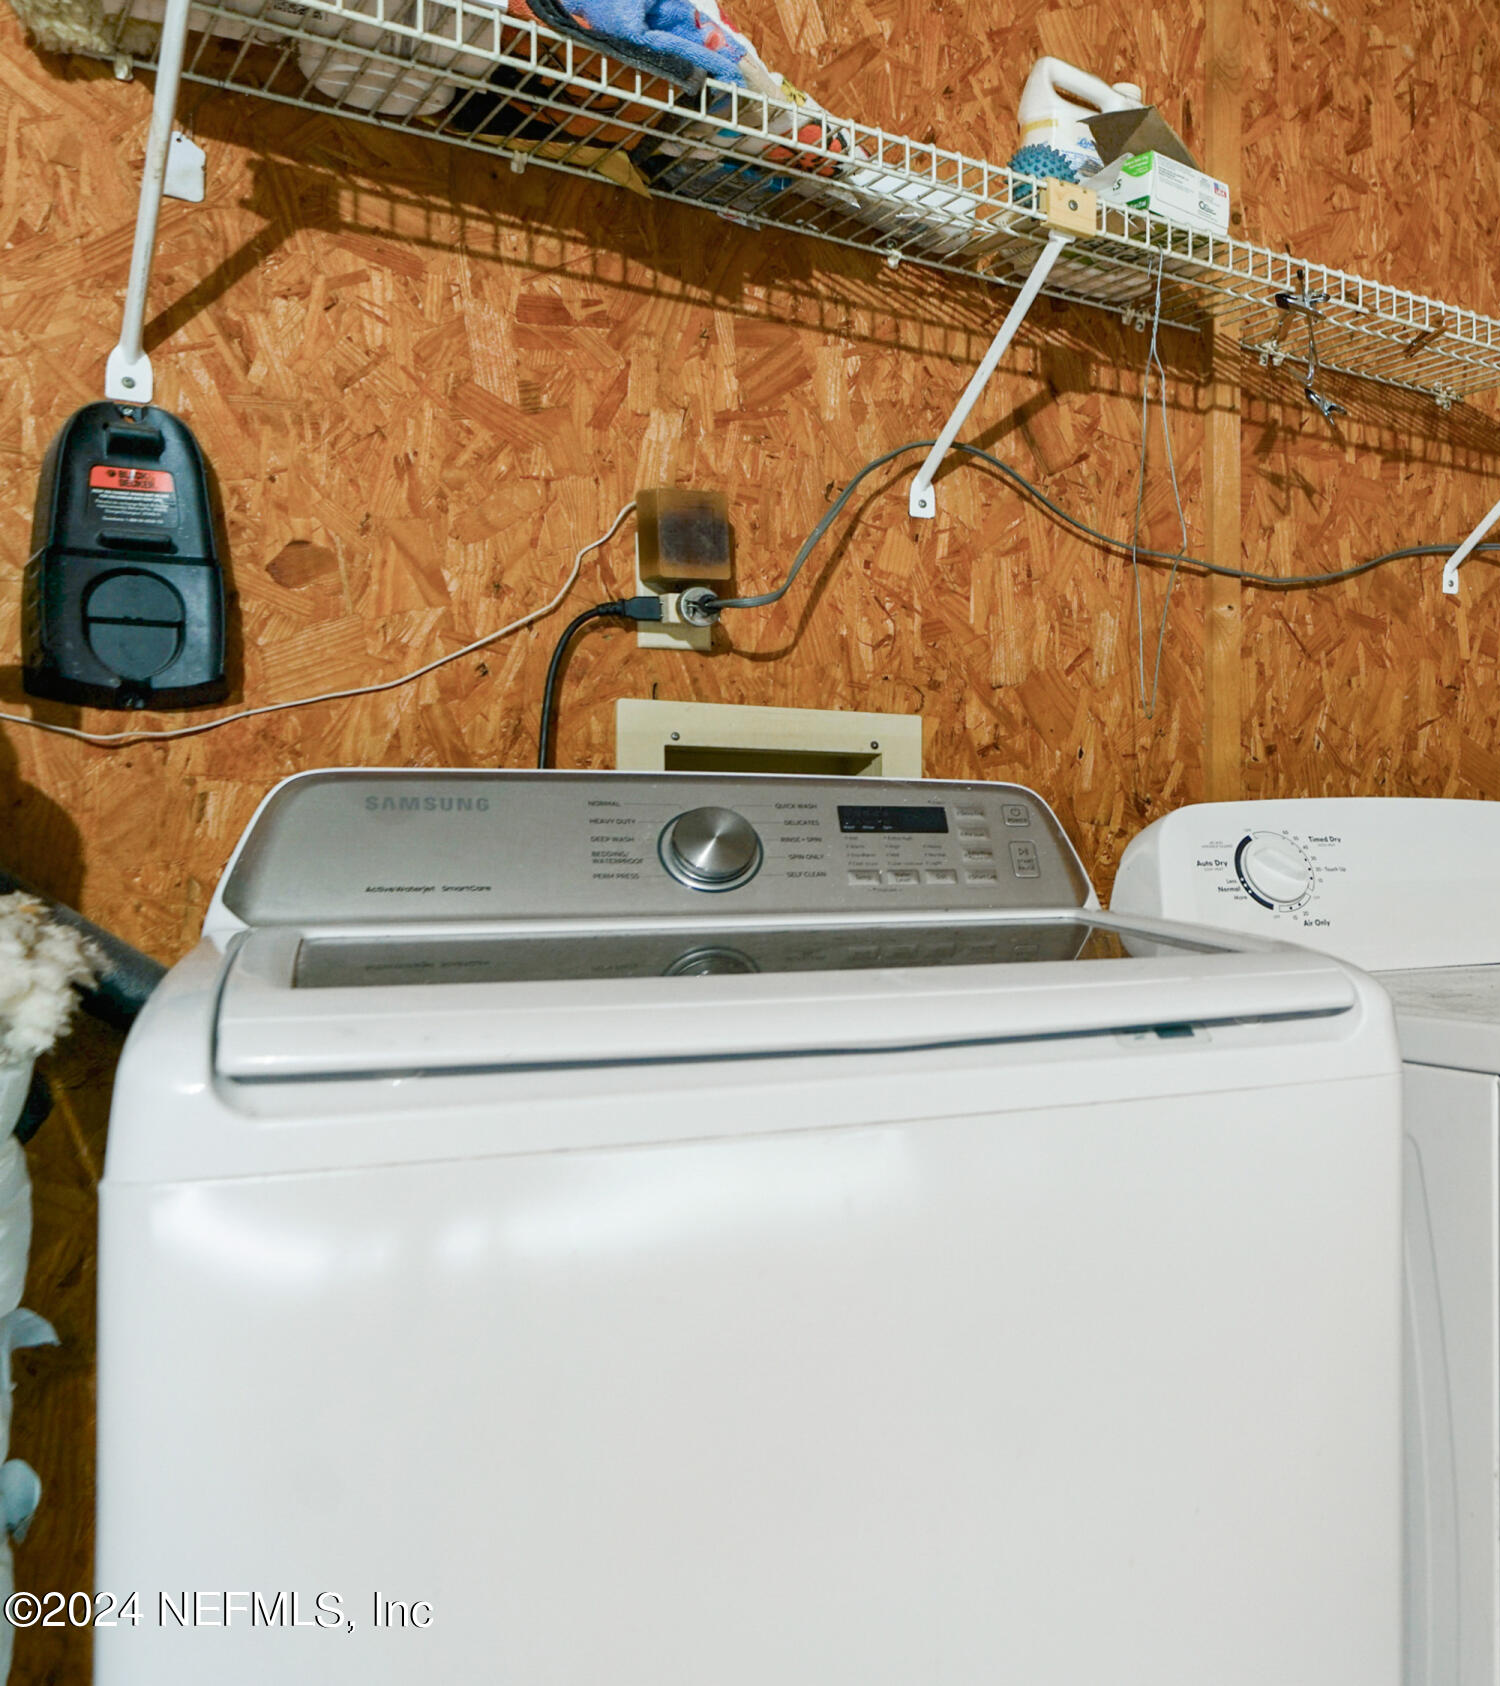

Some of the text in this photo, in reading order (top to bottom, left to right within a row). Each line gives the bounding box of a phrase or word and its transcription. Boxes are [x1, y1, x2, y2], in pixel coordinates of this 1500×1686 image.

[365, 796, 490, 812] SAMSUNG
[775, 802, 796, 810] QUICK
[1328, 835, 1341, 843] Dry
[1196, 859, 1228, 868] Auto Dry
[615, 872, 640, 880] PRESS
[1314, 919, 1331, 927] Only
